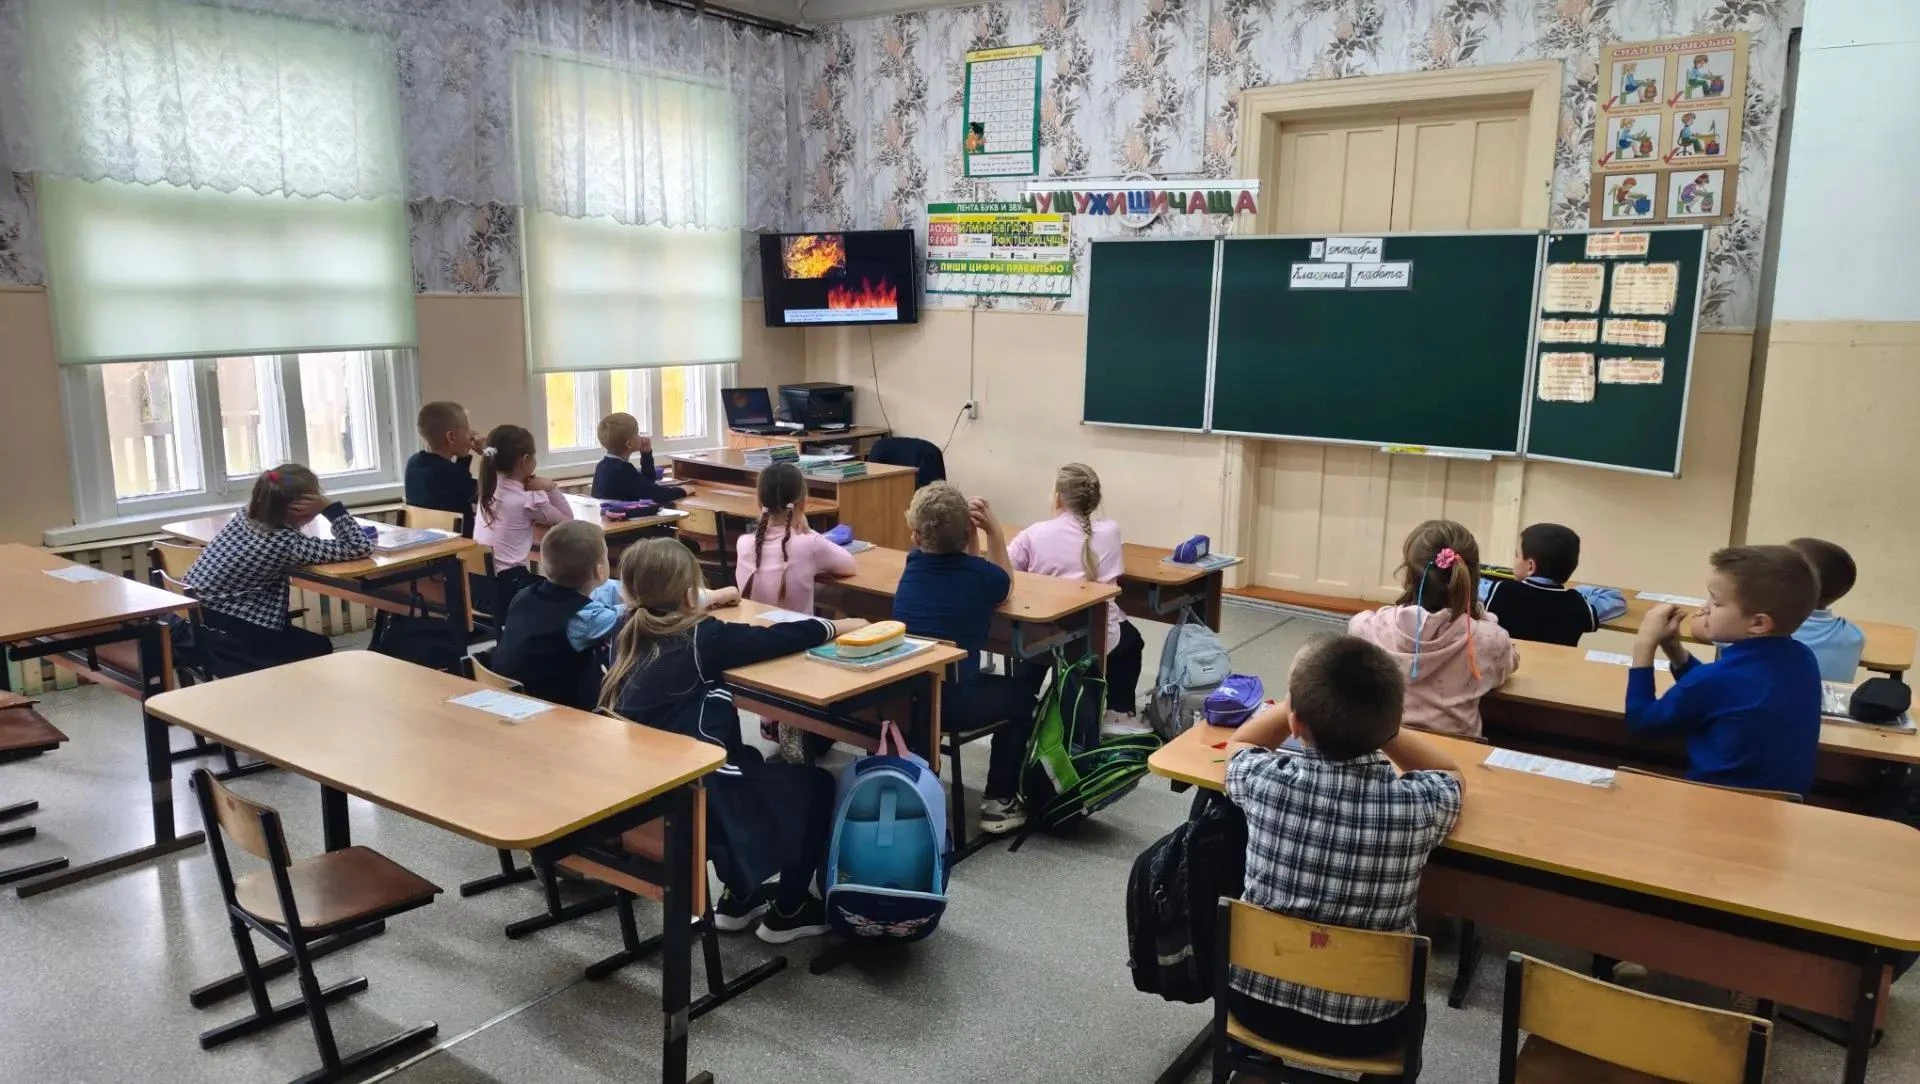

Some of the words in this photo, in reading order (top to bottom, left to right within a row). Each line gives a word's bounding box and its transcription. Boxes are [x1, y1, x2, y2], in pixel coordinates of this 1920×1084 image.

[1654, 37, 1737, 53] ПРАВИЛЬНО
[956, 203, 979, 212] ЛЕНТА
[980, 203, 999, 212] БУКВ
[1001, 203, 1007, 211] И
[1327, 240, 1379, 260] октября
[940, 263, 967, 271] ПИШИ
[969, 263, 1003, 272] ЦИФРЫ
[1006, 263, 1064, 273] ПРАВИЛЬНО
[1292, 266, 1346, 280] Классная
[1354, 265, 1405, 284] работа
